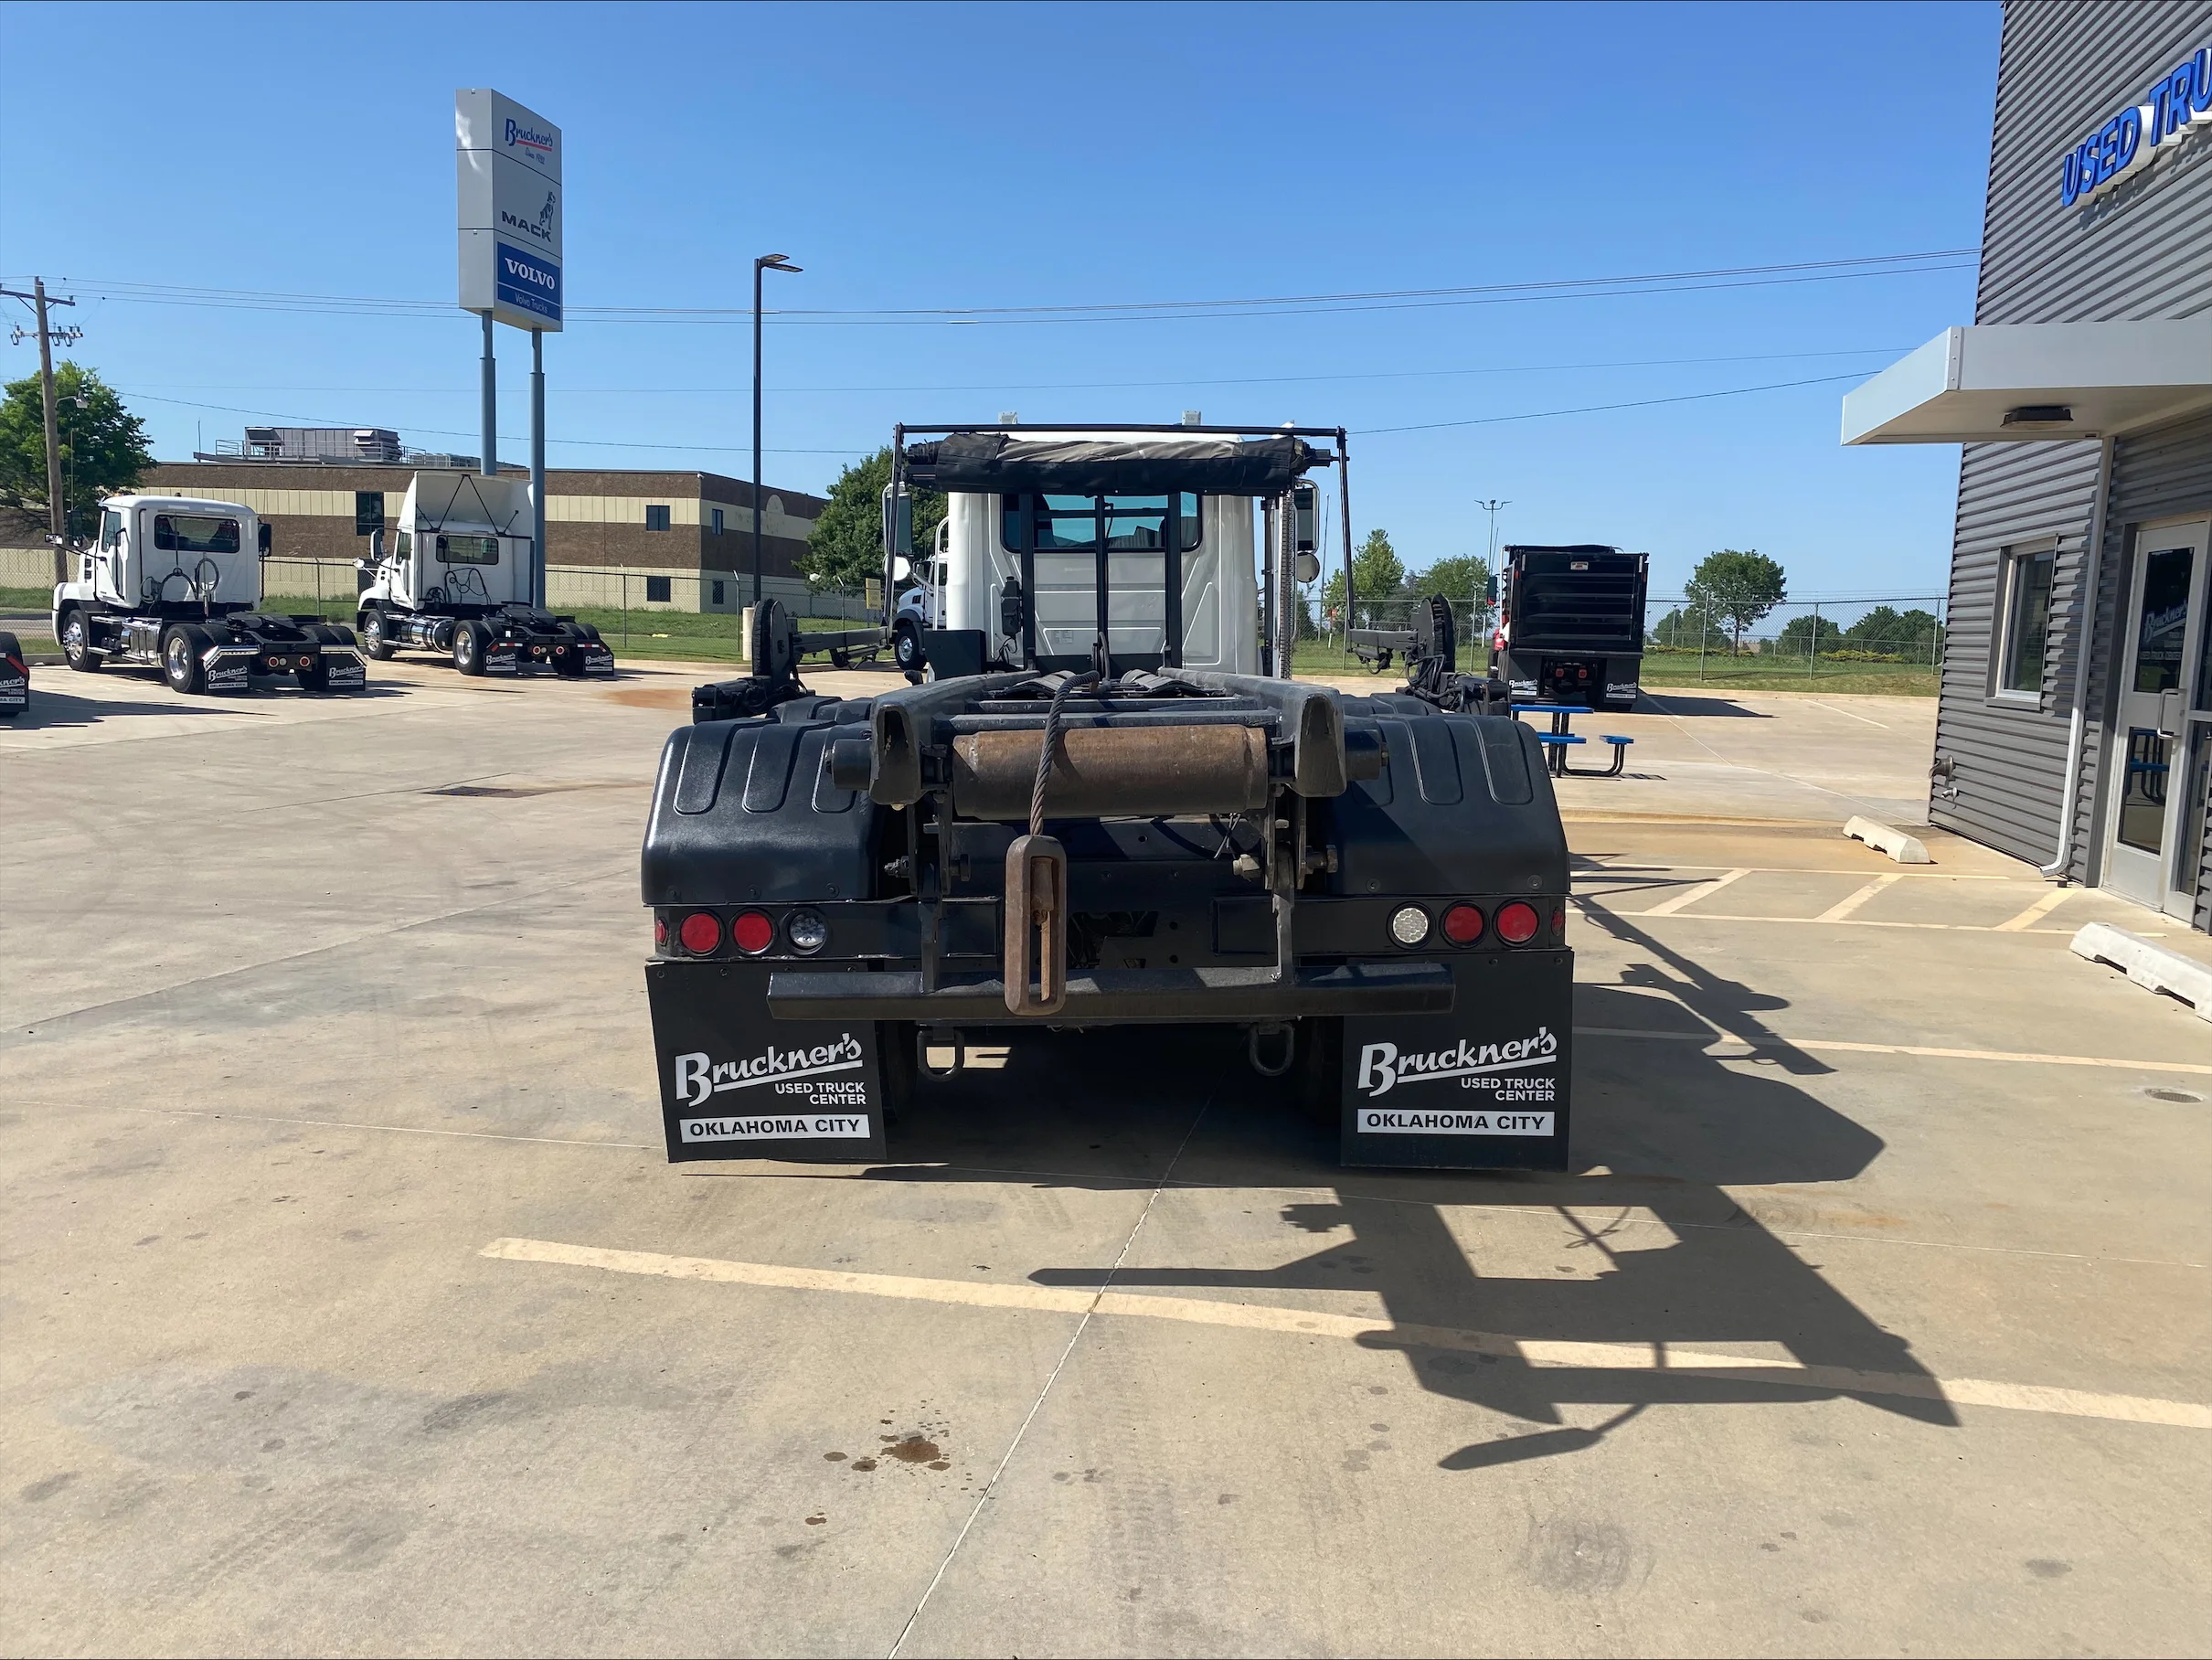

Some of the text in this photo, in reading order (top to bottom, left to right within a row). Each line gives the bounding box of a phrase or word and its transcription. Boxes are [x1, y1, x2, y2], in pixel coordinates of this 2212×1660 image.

[505, 118, 553, 147] Bruckner's
[2061, 105, 2143, 207] USED
[502, 210, 552, 243] MACK
[505, 257, 556, 291] VOLVO
[515, 292, 548, 314] Volvo Trucks
[675, 1032, 863, 1108] Bruckner's
[1357, 1026, 1558, 1098] Bruckner's
[775, 1081, 866, 1094] USED TRUCK
[1461, 1078, 1556, 1090] USED TRUCK
[809, 1094, 867, 1105] CENTER
[1494, 1090, 1555, 1101] CENTER
[689, 1118, 860, 1136] OKLAHOMA CITY
[1367, 1113, 1546, 1130] OKLAHOMA CITY
